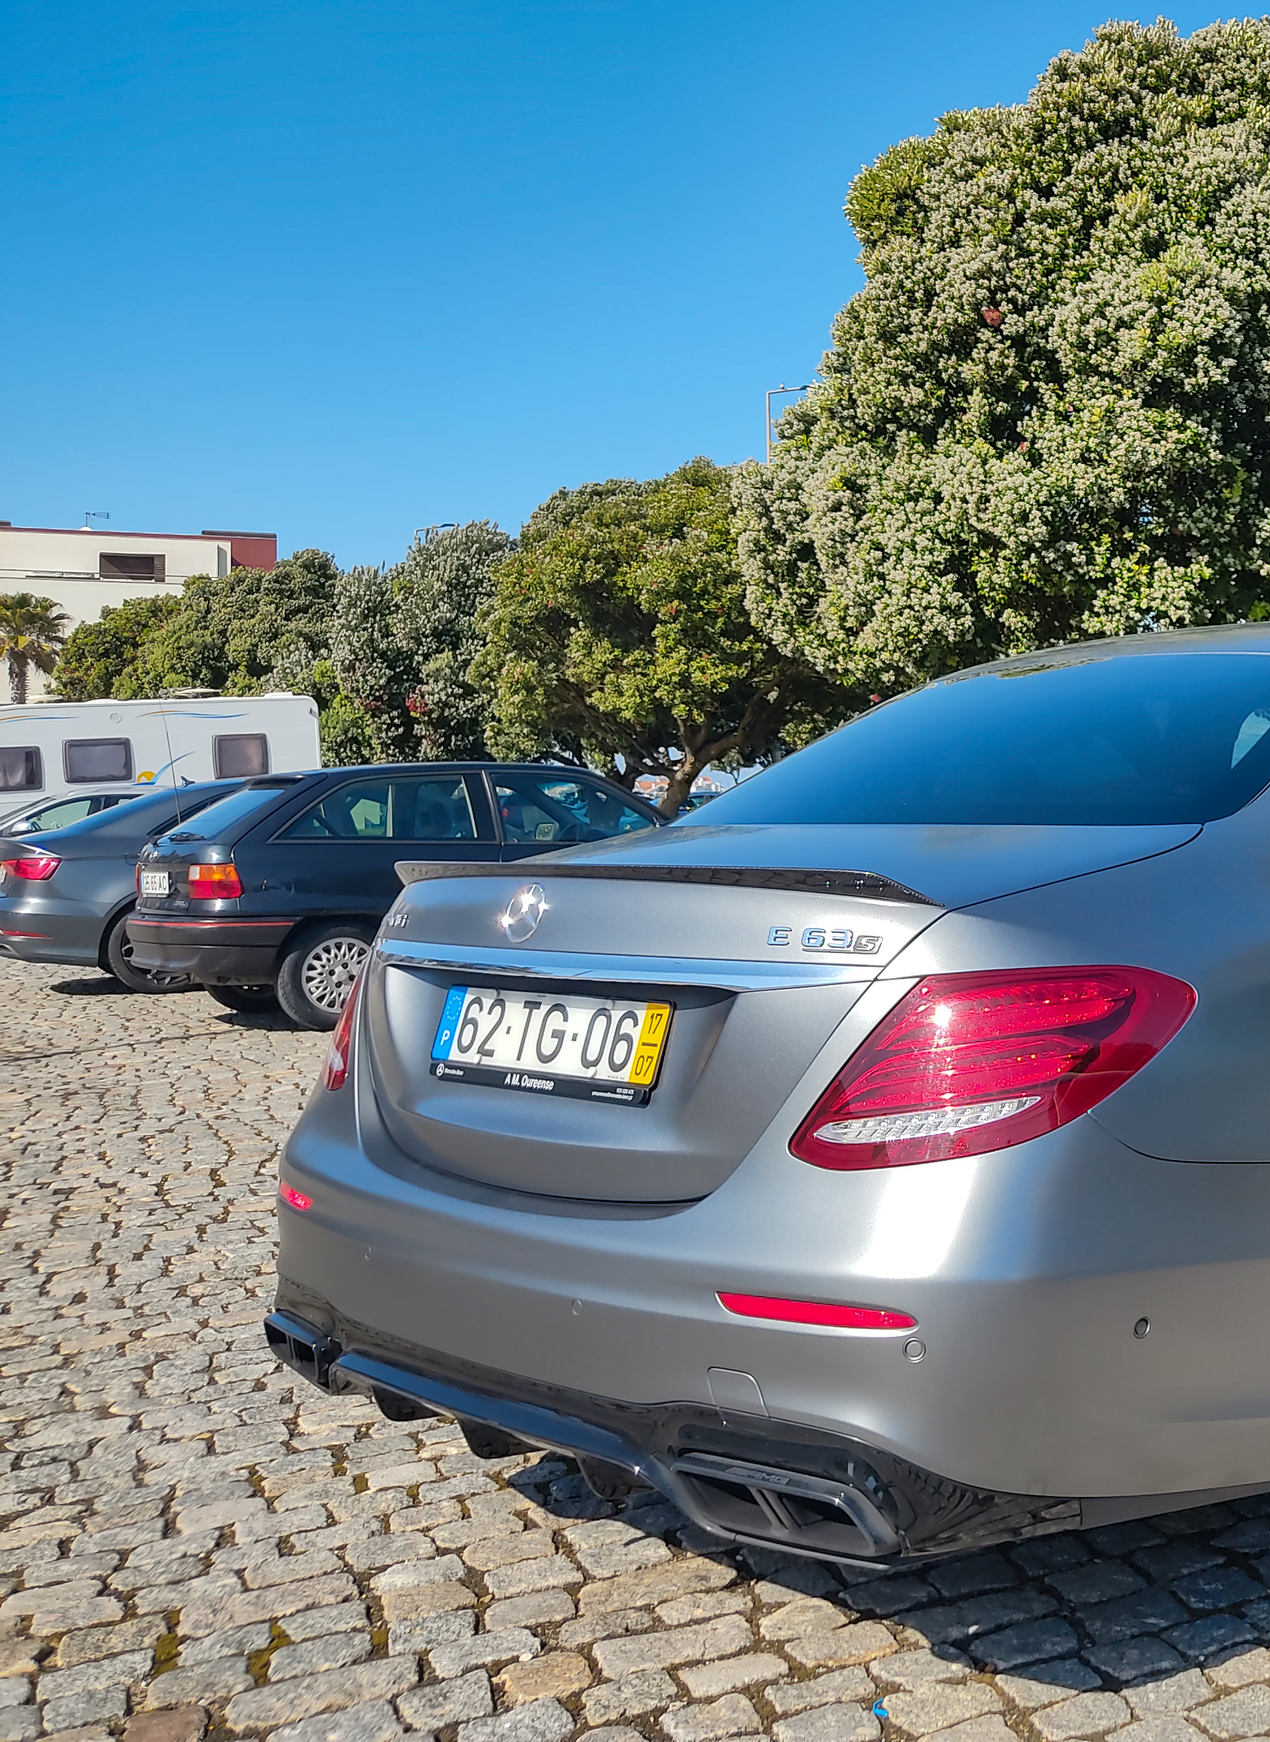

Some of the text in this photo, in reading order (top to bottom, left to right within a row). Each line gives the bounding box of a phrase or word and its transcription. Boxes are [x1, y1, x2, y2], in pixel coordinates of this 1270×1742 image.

[766, 925, 792, 946] E
[650, 1013, 663, 1034] 17
[440, 1029, 451, 1046] P
[635, 1055, 654, 1077] 07
[504, 1073, 555, 1091] A M. Oureense
[745, 1470, 790, 1485] AMG
